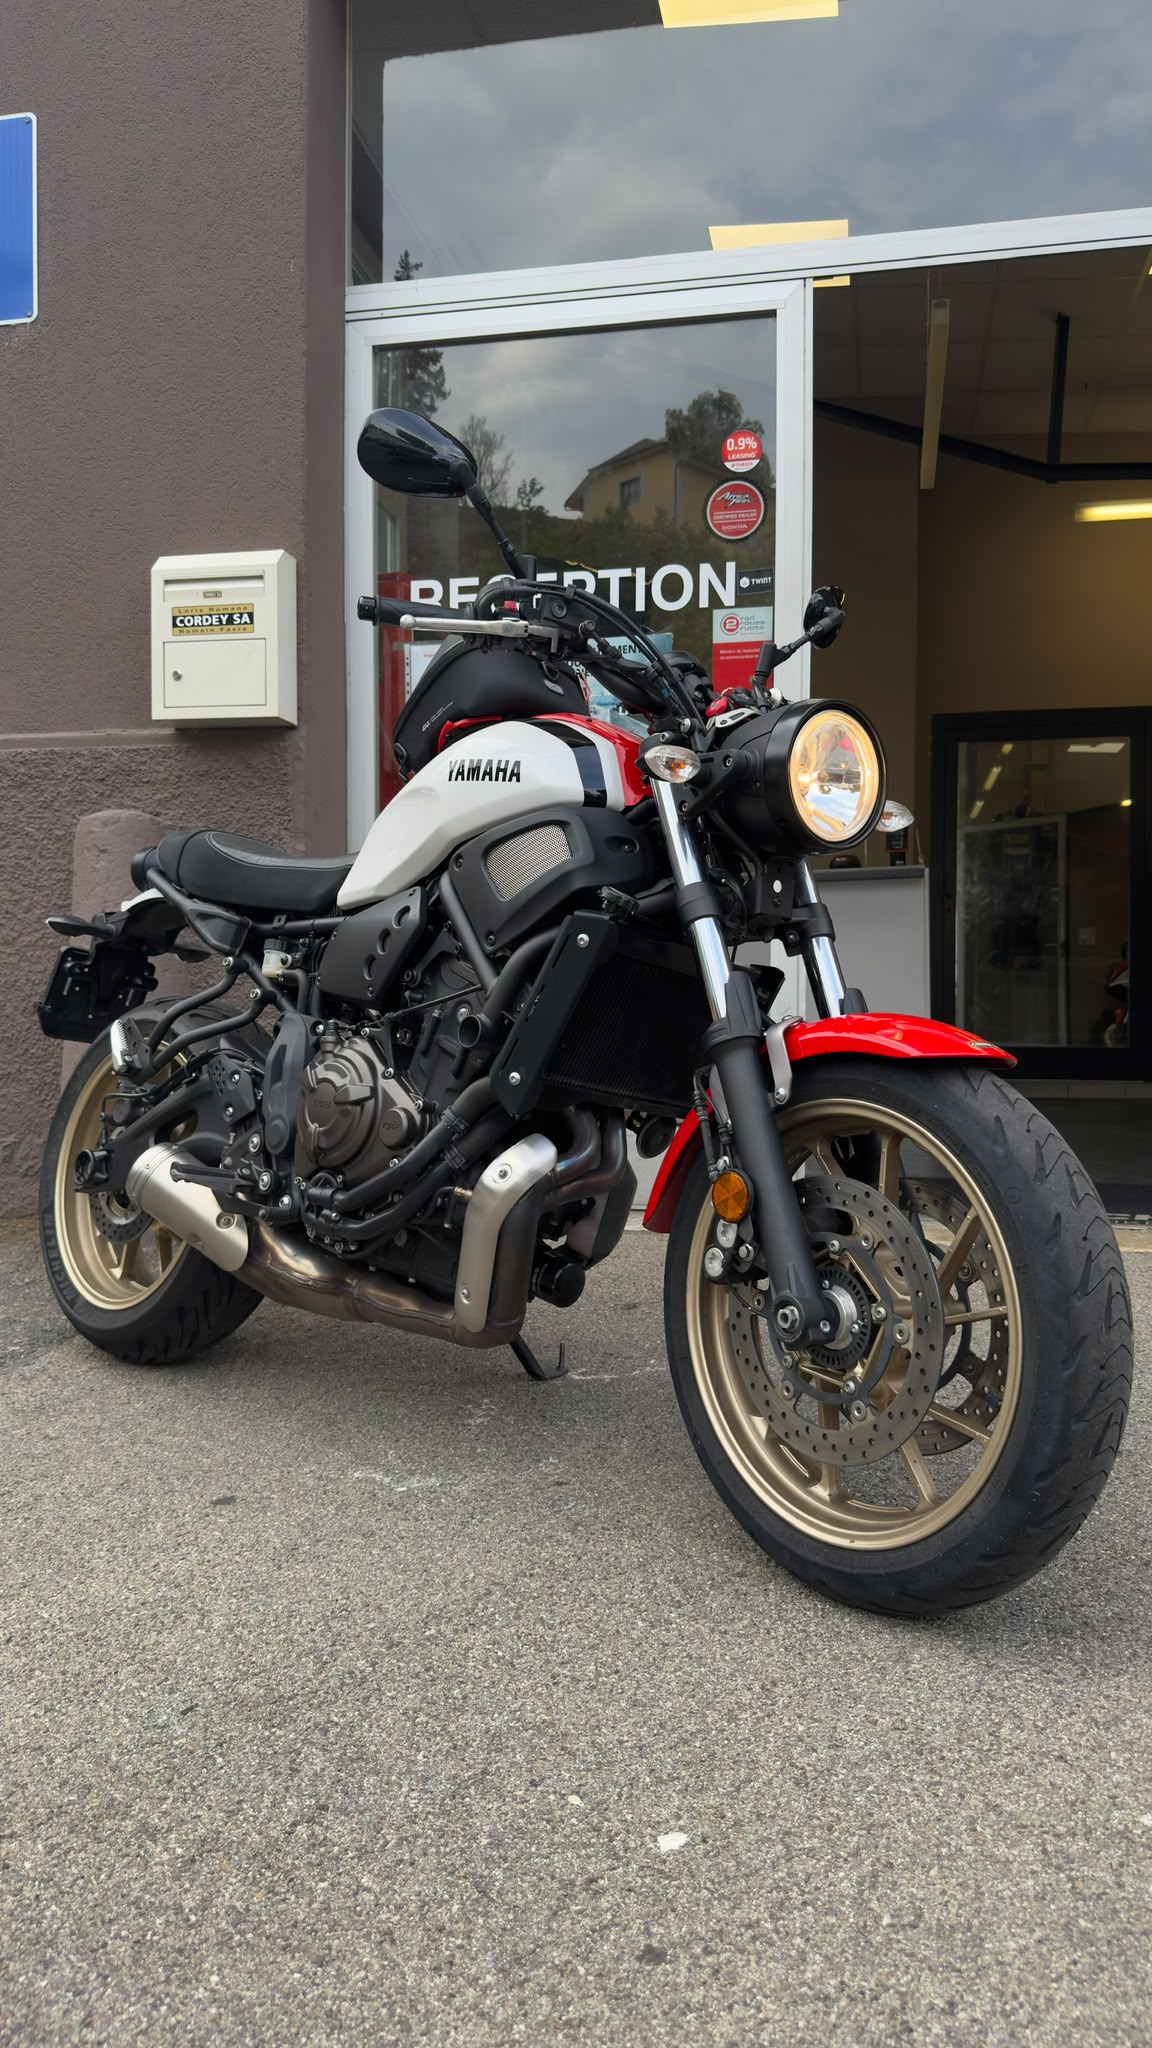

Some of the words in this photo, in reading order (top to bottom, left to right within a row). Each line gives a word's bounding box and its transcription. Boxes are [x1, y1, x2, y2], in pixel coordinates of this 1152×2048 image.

[726, 437, 757, 451] 0.9%
[176, 614, 229, 627] CORDEY
[233, 613, 251, 624] SA
[448, 758, 521, 783] YAMAHA
